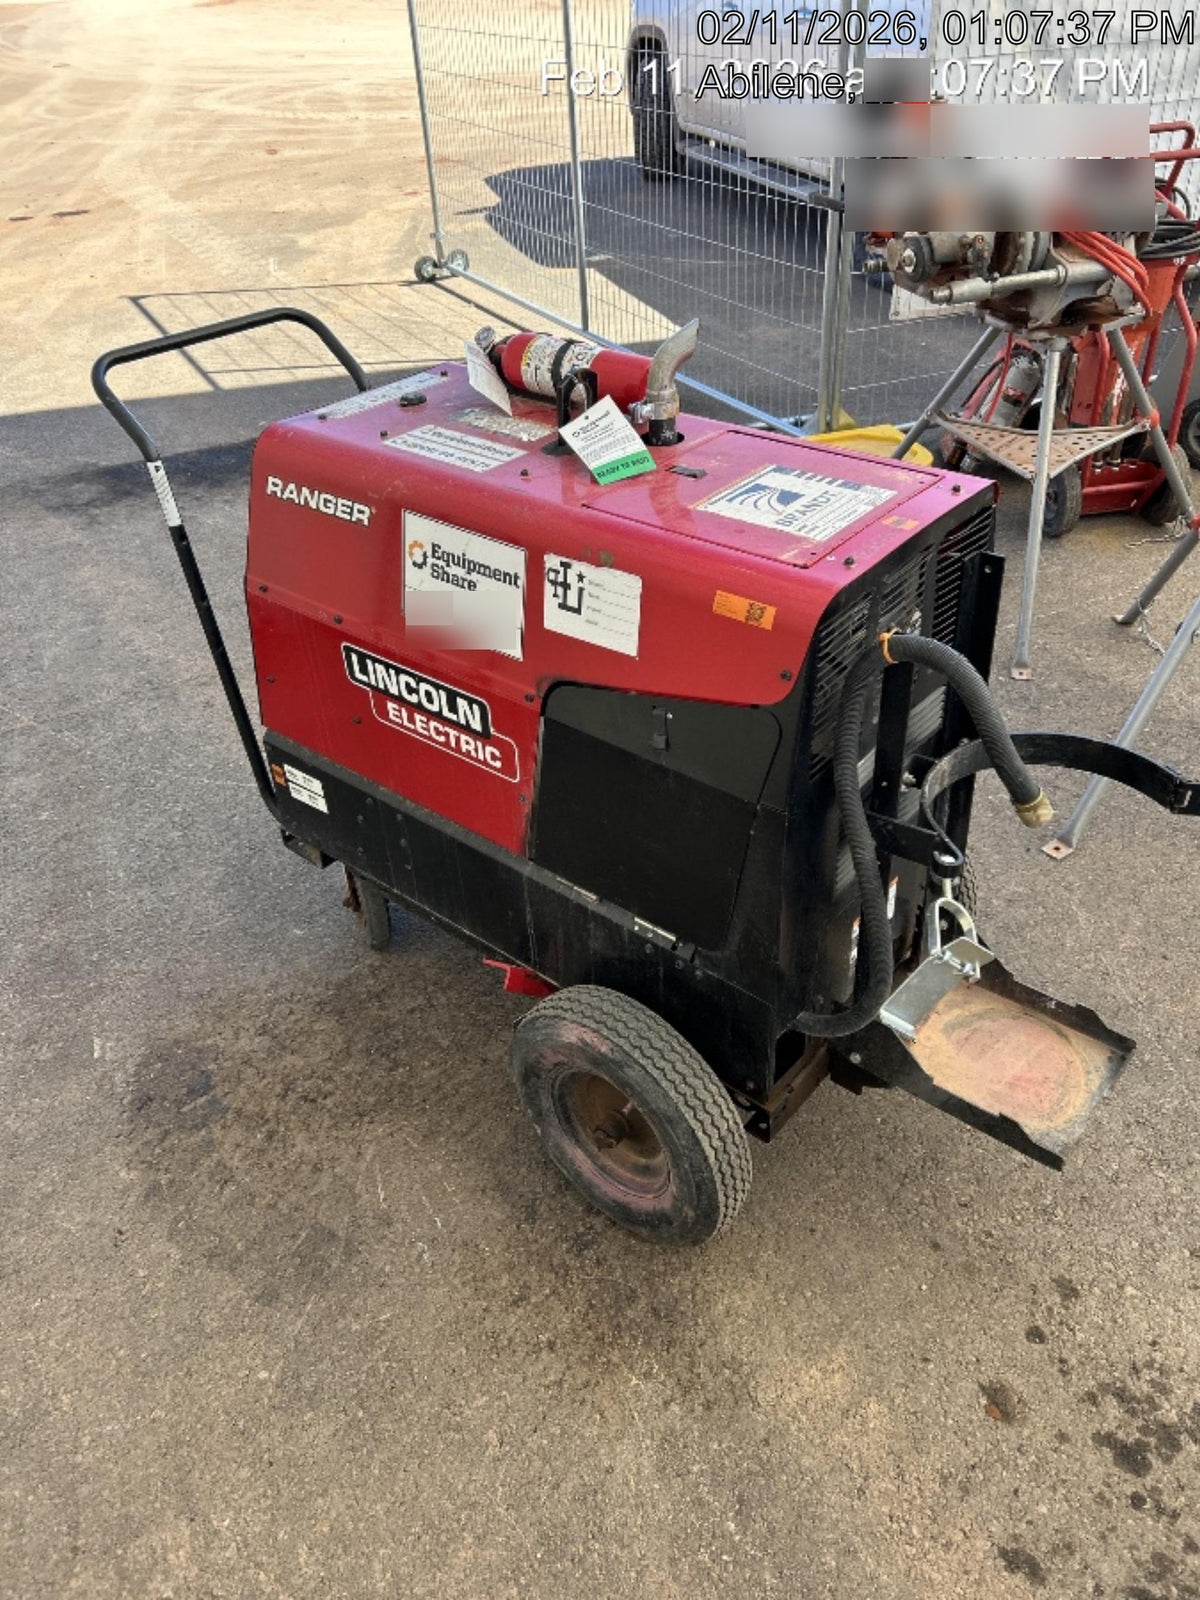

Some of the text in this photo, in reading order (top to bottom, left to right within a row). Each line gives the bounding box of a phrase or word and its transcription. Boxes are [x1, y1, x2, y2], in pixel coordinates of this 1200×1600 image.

[266, 475, 371, 527] RANGER
[431, 542, 521, 589] Equipment
[431, 562, 477, 592] Share
[351, 652, 483, 733] LINCOLN
[387, 700, 502, 769] ELECTRIC
